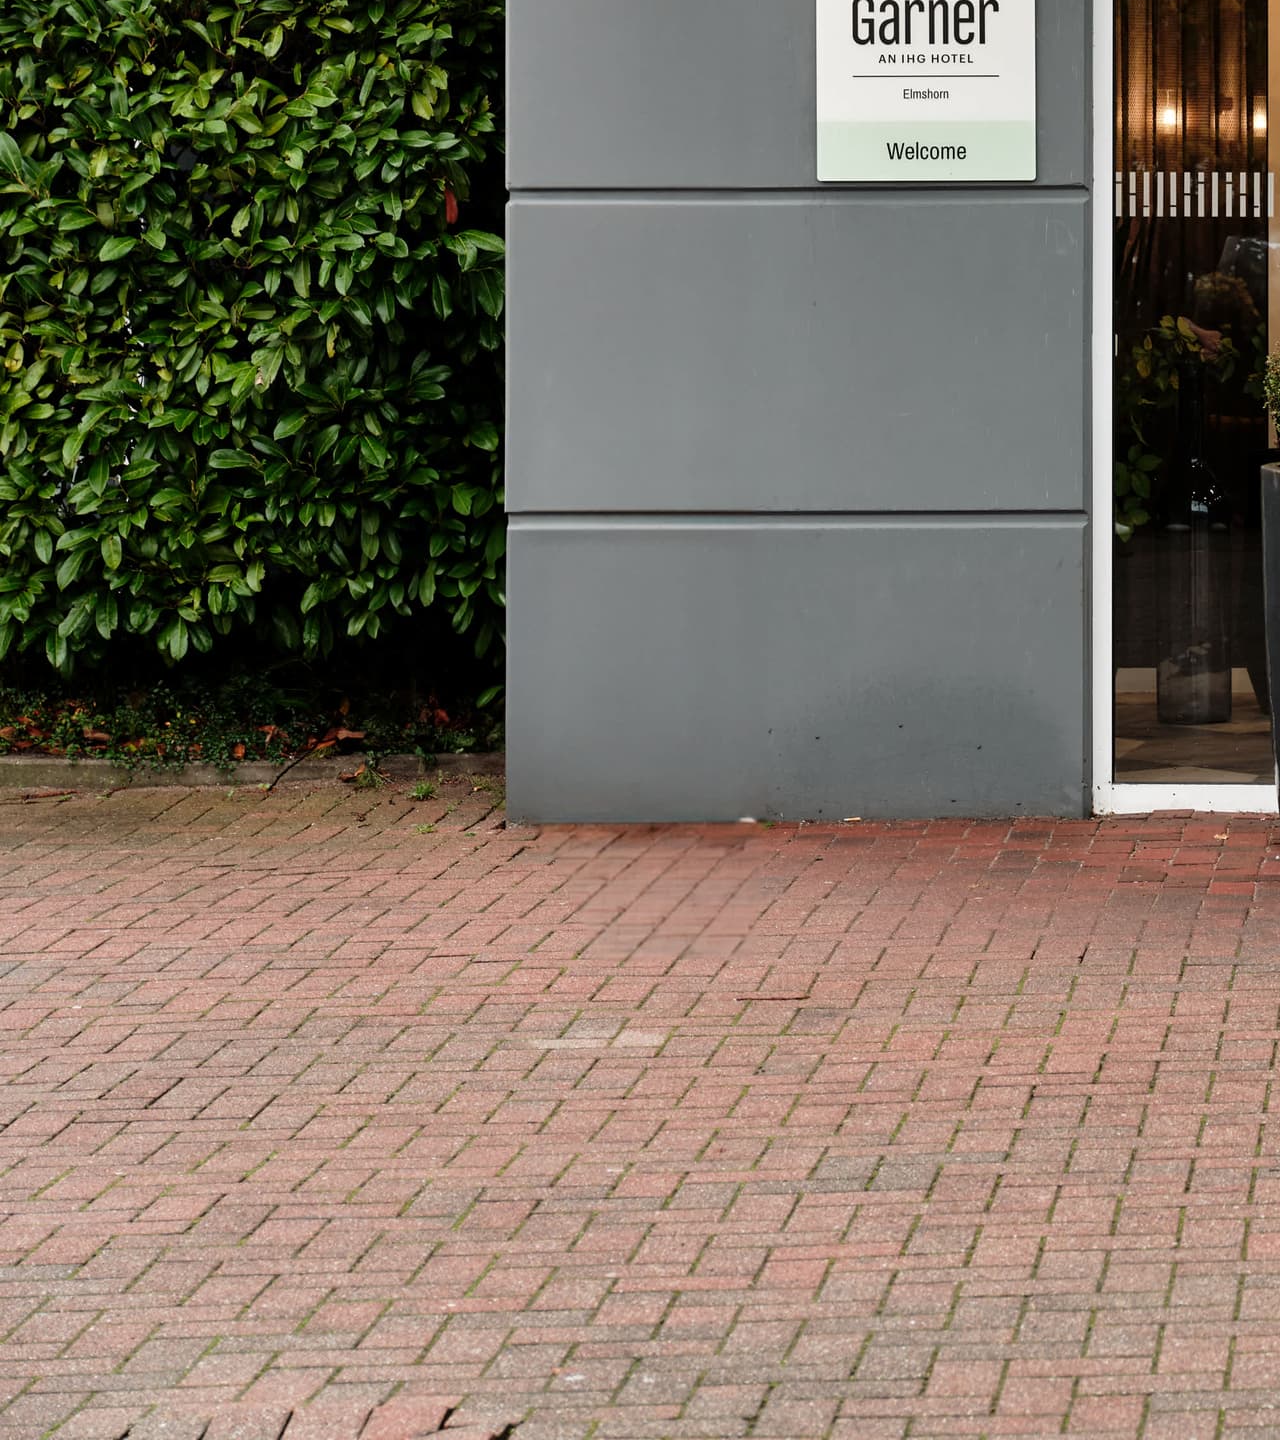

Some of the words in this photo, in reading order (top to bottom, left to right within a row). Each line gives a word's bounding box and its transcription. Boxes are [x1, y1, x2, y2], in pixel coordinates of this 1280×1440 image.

[878, 54, 897, 64] AN
[901, 54, 926, 64] IHG
[931, 53, 974, 64] HOTEL
[903, 89, 949, 99] Elmshorn
[886, 142, 967, 160] Welcome
